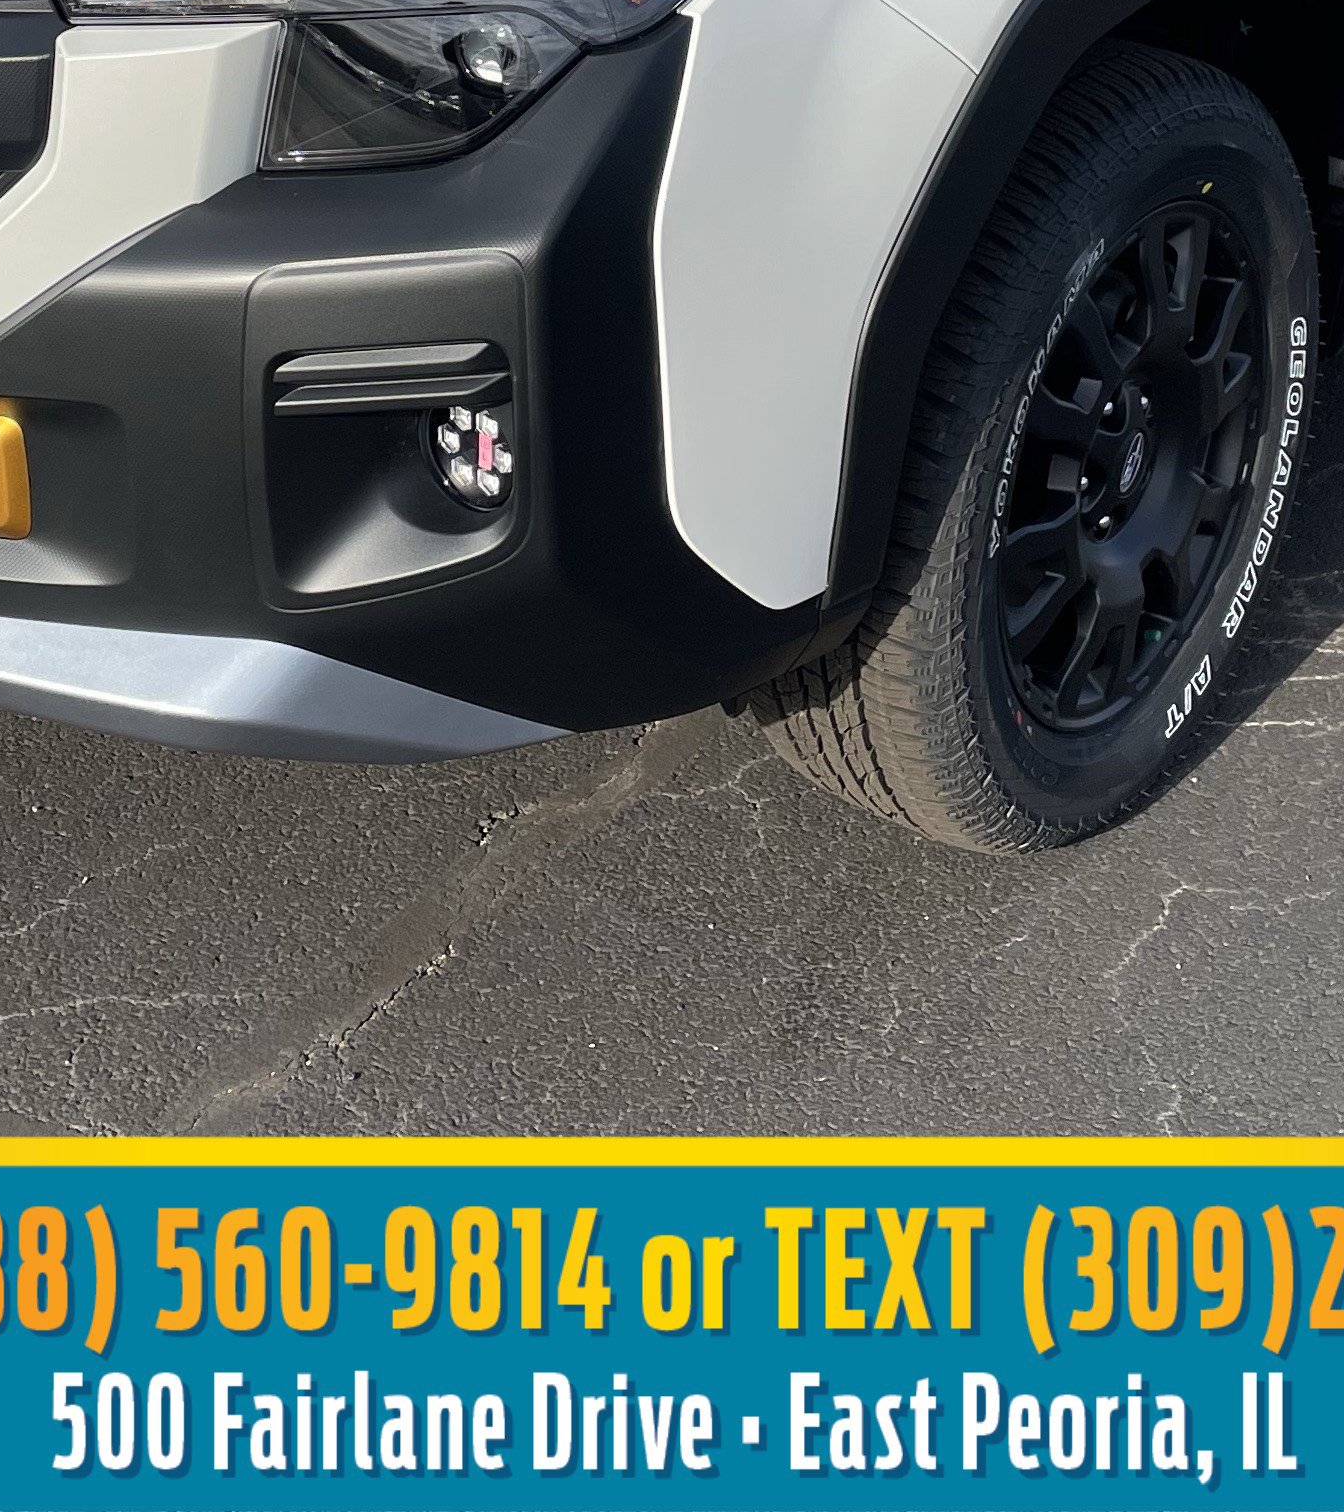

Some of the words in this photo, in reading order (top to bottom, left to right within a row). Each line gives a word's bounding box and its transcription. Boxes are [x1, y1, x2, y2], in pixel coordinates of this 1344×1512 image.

[988, 237, 1105, 559] YOKOHAMA
[1220, 316, 1308, 639] GEOLANDAR
[1164, 654, 1213, 739] A/T
